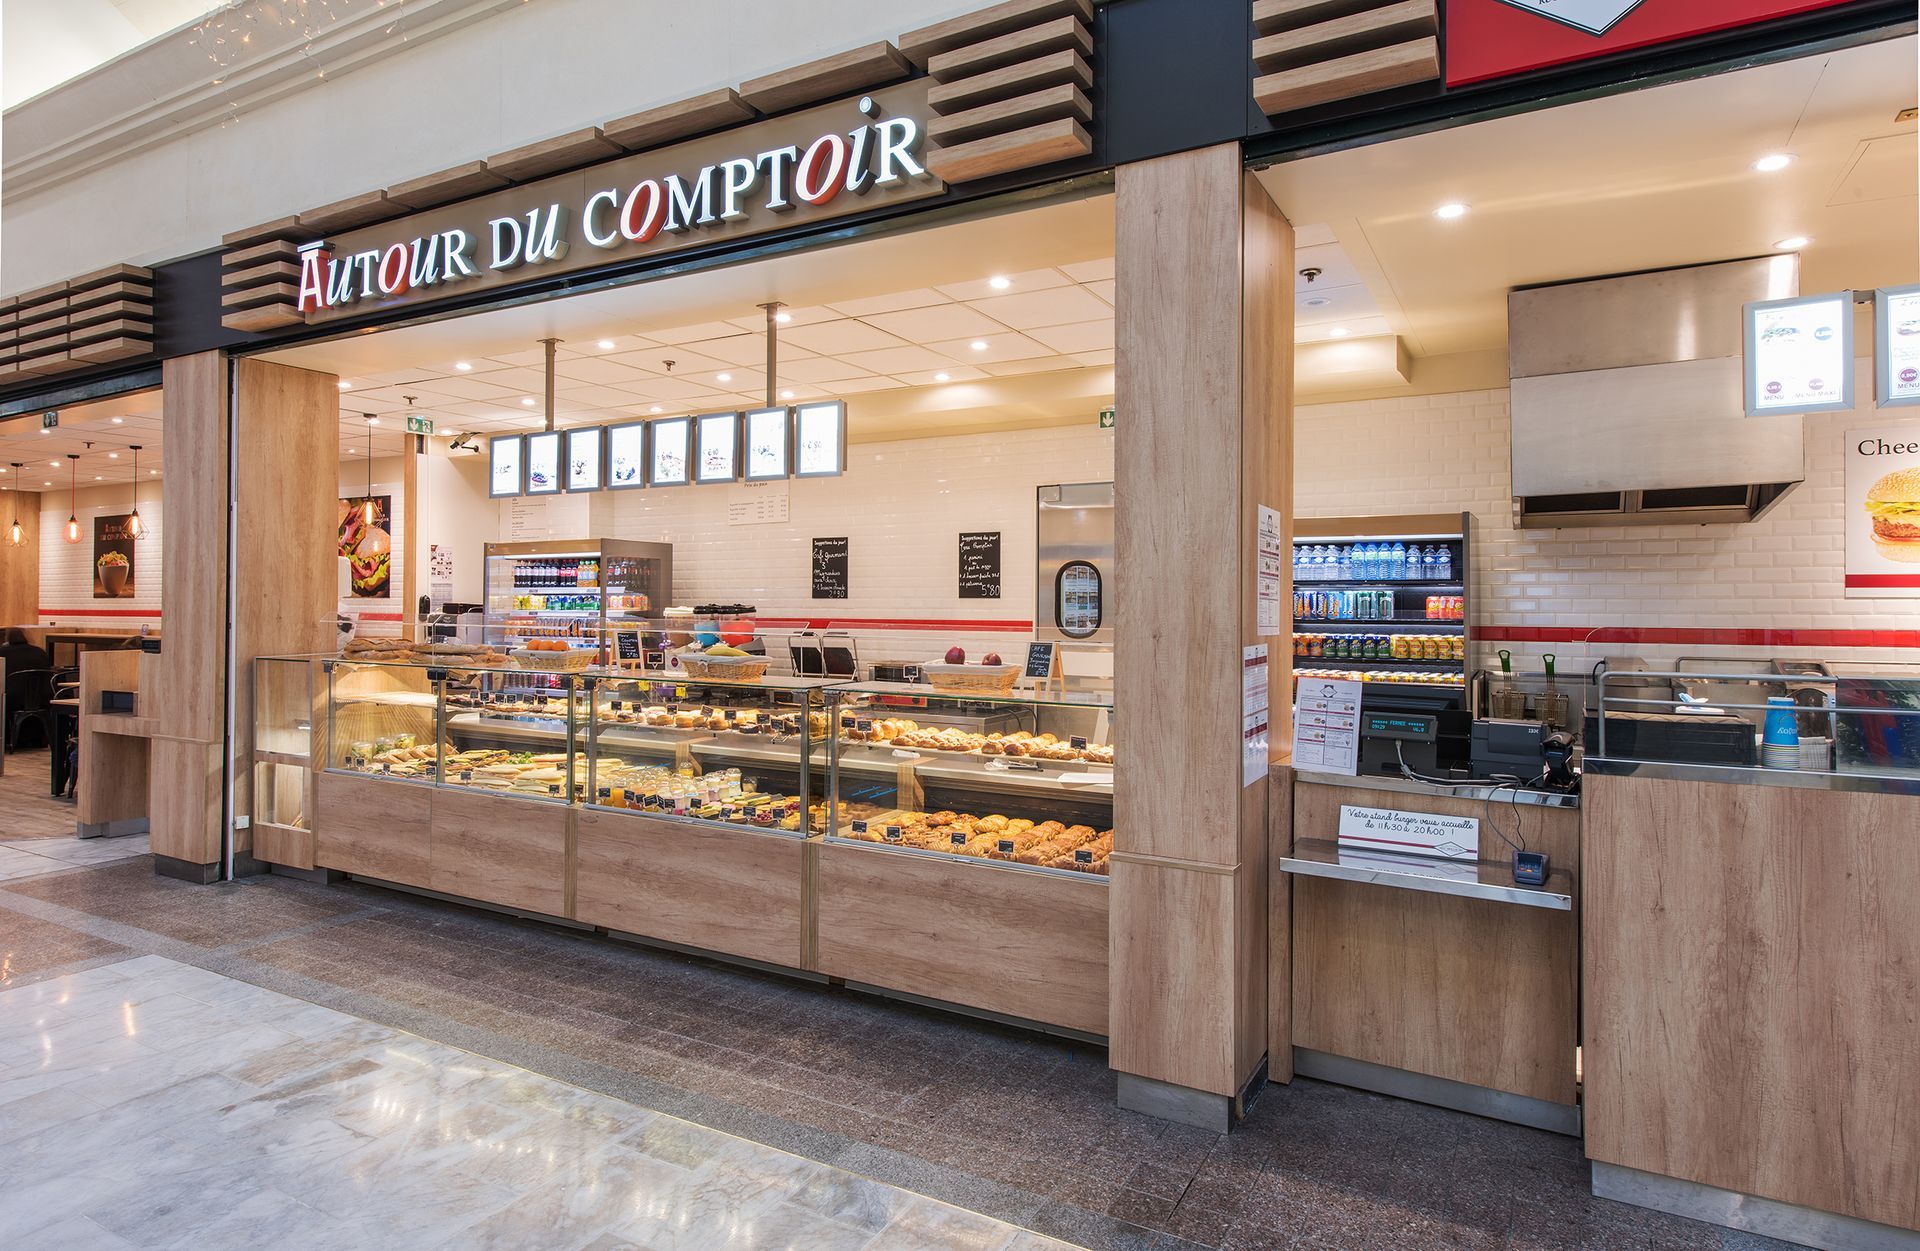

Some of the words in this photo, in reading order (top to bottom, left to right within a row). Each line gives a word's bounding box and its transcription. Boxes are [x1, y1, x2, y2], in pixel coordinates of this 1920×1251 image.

[487, 203, 564, 270] DU
[1857, 438, 1919, 456] Chee
[1347, 808, 1369, 819] Votre
[1370, 812, 1392, 823] stand
[1393, 813, 1417, 827] burger
[1419, 818, 1440, 826] vous
[1364, 820, 1374, 829] de
